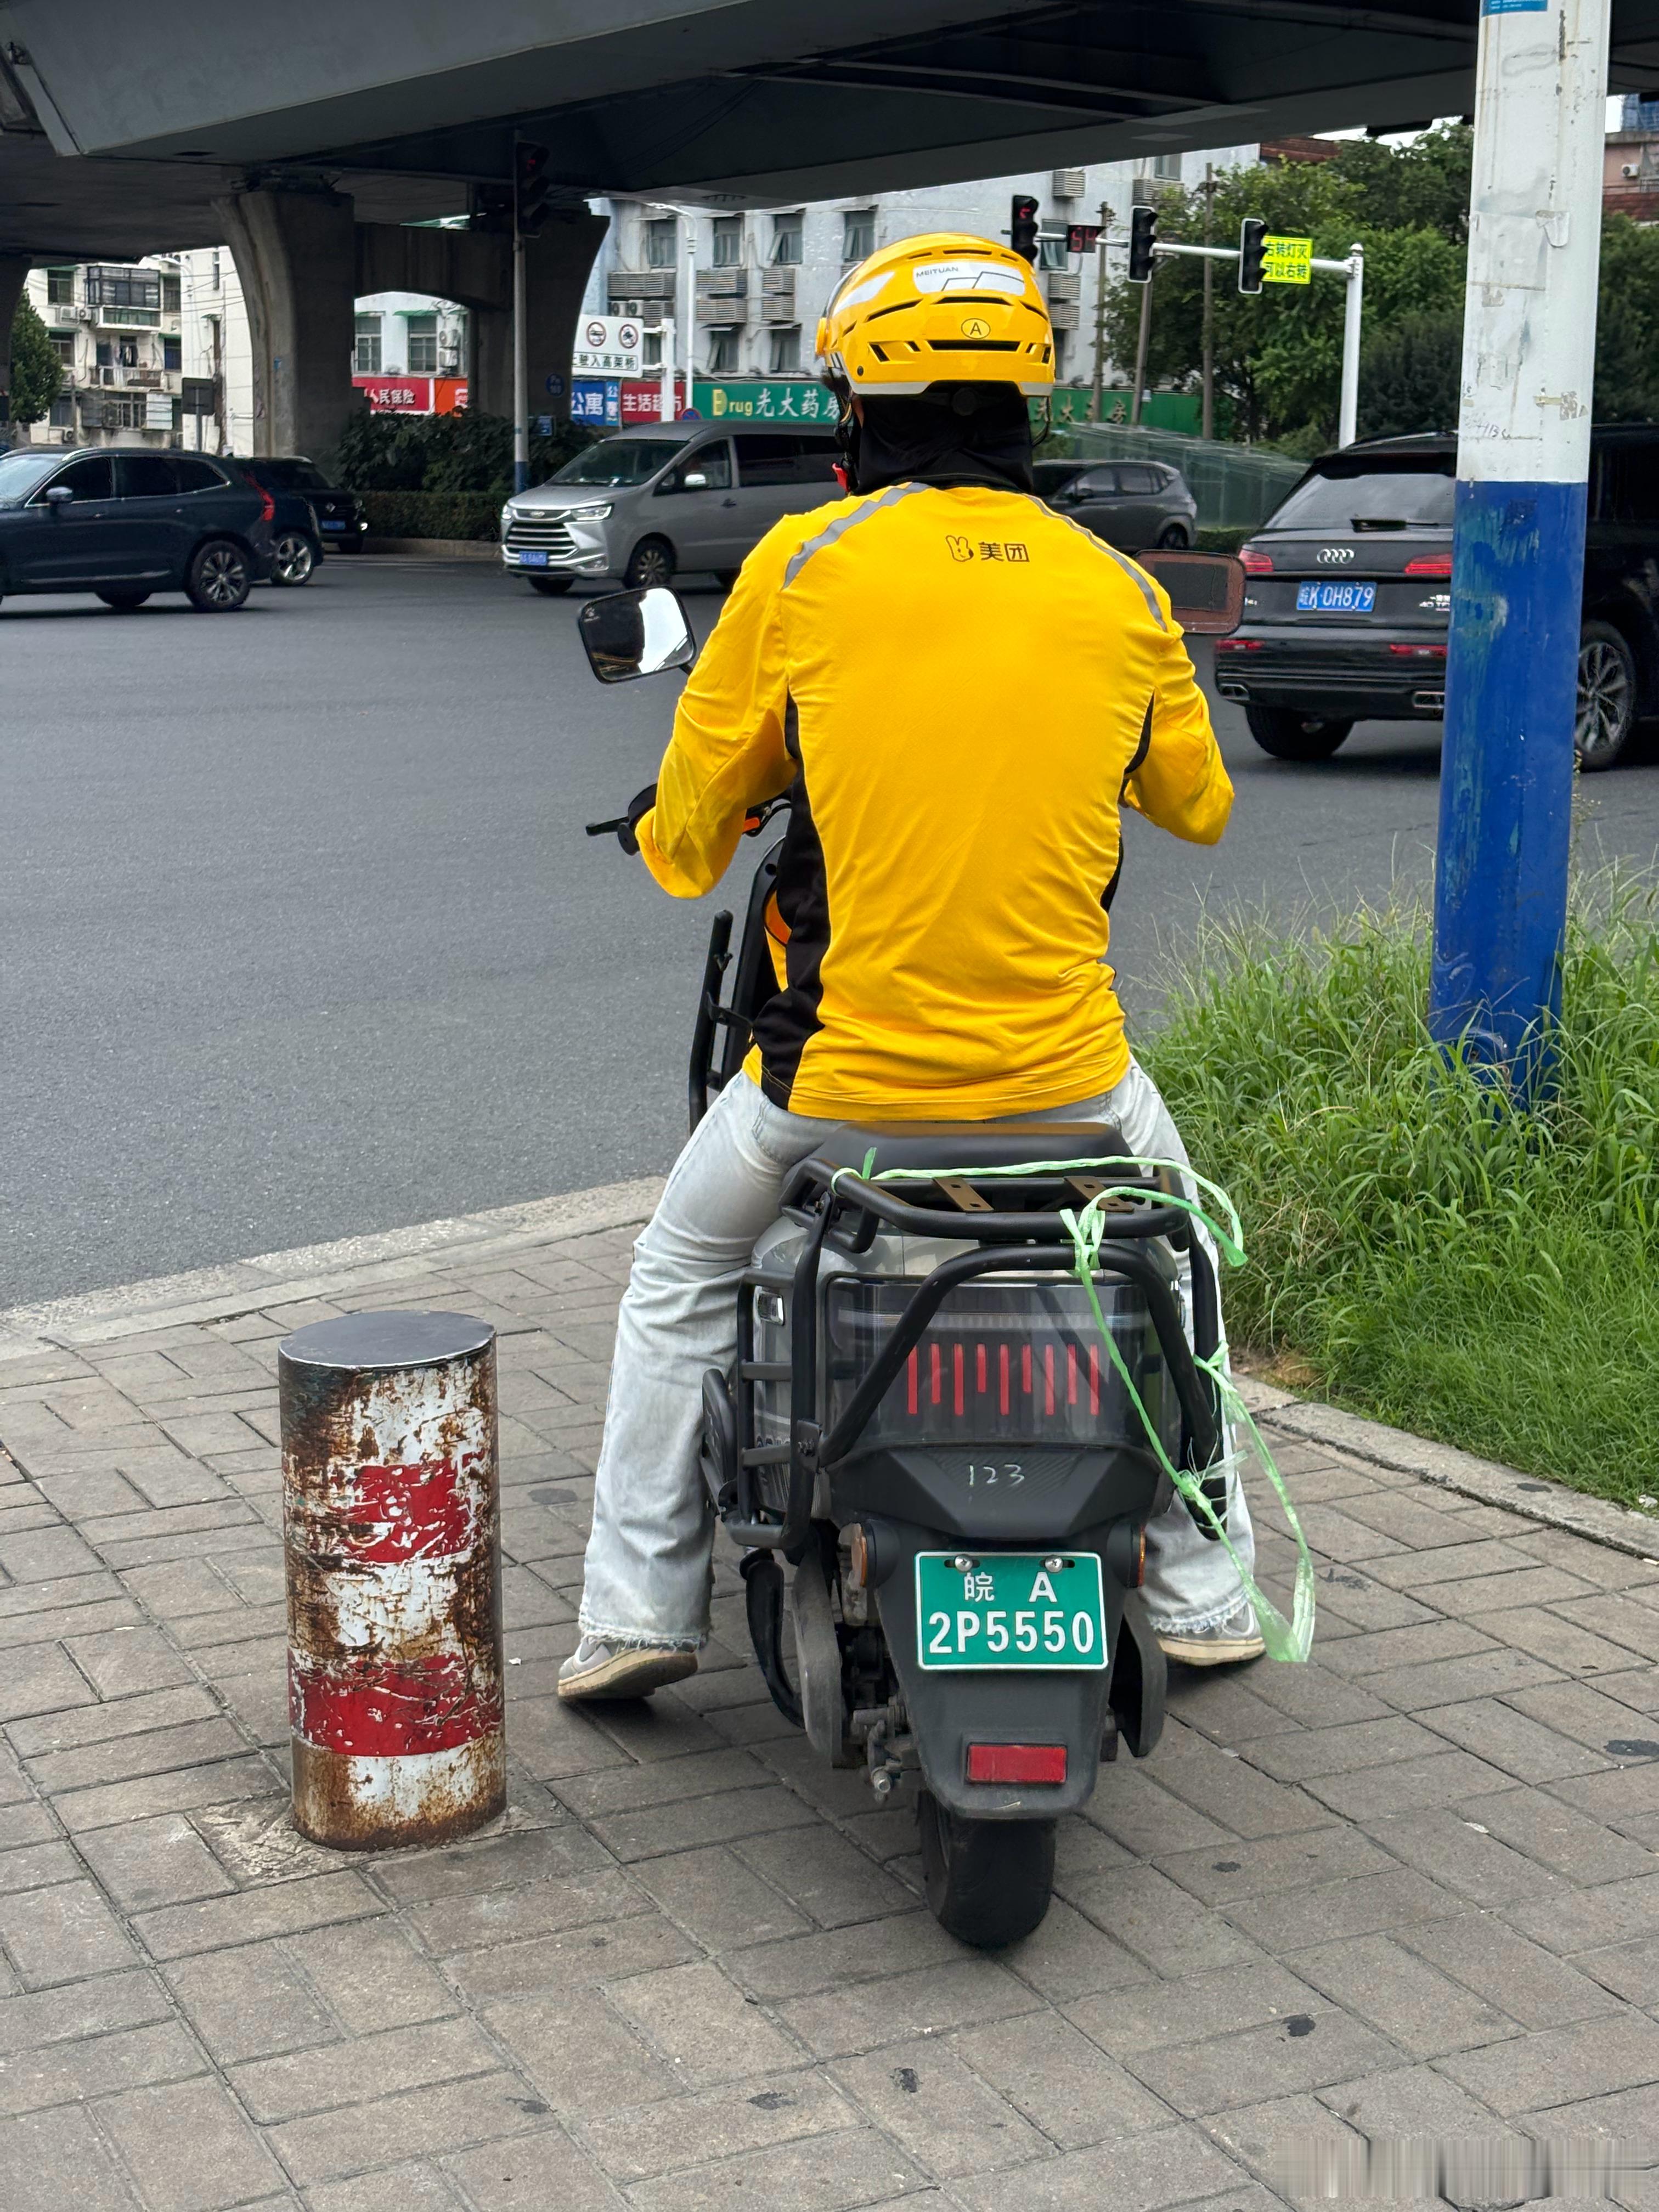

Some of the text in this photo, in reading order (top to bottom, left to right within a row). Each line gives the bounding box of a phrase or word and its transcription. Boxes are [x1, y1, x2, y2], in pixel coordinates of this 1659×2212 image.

[916, 267, 958, 277] MEITUAN
[970, 323, 981, 336] A
[364, 388, 416, 404] 人民保险
[571, 392, 603, 415] 公寓
[978, 541, 1030, 562] 美团
[968, 1464, 1025, 1486] 123
[963, 1571, 1057, 1603] 皖 A
[929, 1610, 1094, 1654] 2P5550
